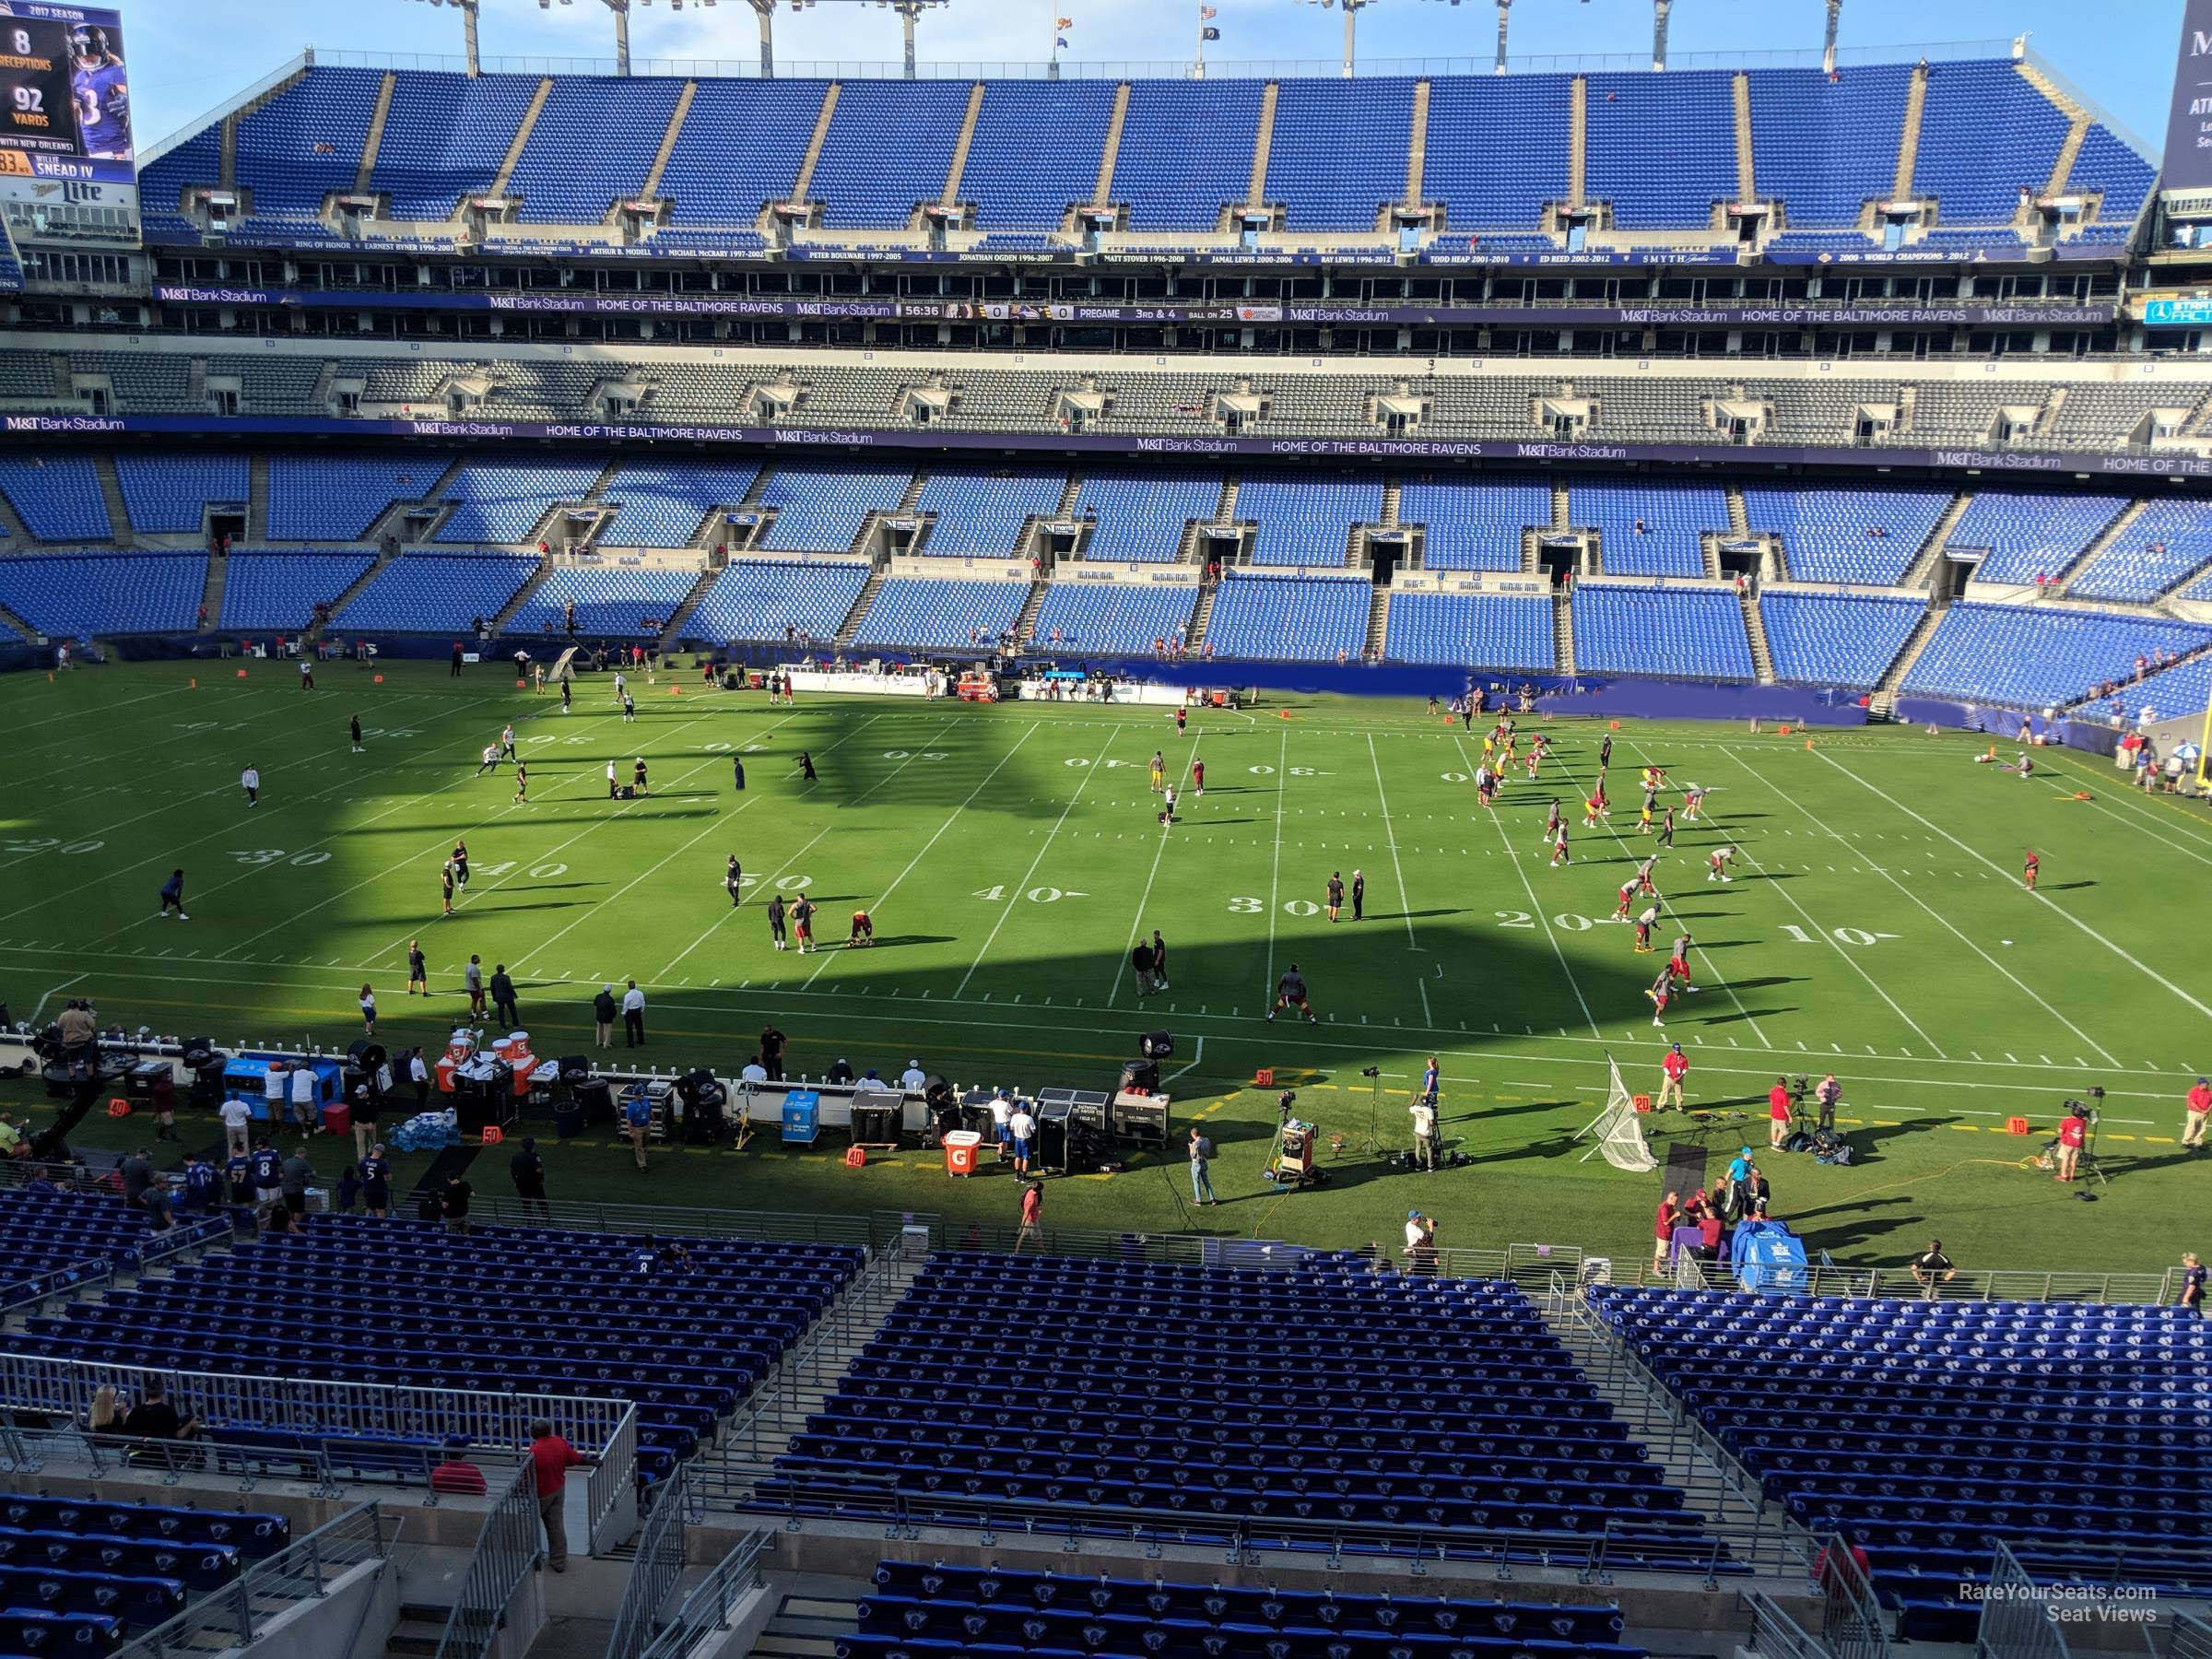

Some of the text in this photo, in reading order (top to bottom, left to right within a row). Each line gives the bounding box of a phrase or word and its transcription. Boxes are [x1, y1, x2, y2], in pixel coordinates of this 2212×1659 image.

[29, 6, 85, 20] 2017 SEASON
[14, 29, 31, 55] 8
[0, 55, 52, 71] RECEPTIONS
[14, 87, 44, 113] 92
[12, 112, 50, 127] YARDS
[20, 139, 36, 149] NEW
[39, 141, 74, 153] ORLEANS)
[35, 155, 60, 165] WILLIE
[37, 163, 94, 178] SNEAD IV
[365, 242, 394, 251] EARNEST
[419, 244, 454, 253] 1996-2003
[626, 249, 652, 257] MODELL
[867, 253, 902, 261] 1997-2005
[959, 253, 993, 262] JONATHAN
[1150, 255, 1185, 264] 1996-2008
[1211, 255, 1293, 264] JAMAL LEWIS 2000-2006
[1321, 255, 1391, 264] RAY LEWIS 1996-2012
[1430, 255, 1510, 264] TODD HEAP 2001-2010
[1539, 254, 1610, 264] ED REED 2002-2012
[1642, 255, 1685, 264] SMYTH
[1839, 252, 1970, 262] 2000 WORLD CHAMPIONS 2012
[160, 288, 266, 302] M&T Bank Stadium
[490, 297, 584, 310] M&T Bank Stadium
[596, 300, 783, 313] HOME OF THE BALTIMORE RAVENS
[796, 303, 890, 316] M&T Bank Stadium
[905, 306, 939, 315] 56:36
[993, 307, 1001, 318] 0
[1060, 308, 1068, 319] 0
[1080, 309, 1120, 319] PREGAME
[1135, 310, 1176, 319] 3RD & 4
[1188, 310, 1233, 320] BALL ON 25
[1289, 309, 1389, 322] M&T Bank Stadium
[1620, 310, 1727, 323] M&T Bank Stadium
[1742, 310, 1966, 322] HOME OF THE BALTIMORE RAVENS
[1983, 309, 2103, 322] M&T Bank Stadium
[6, 417, 125, 431] M&T Bank Stadium
[414, 422, 512, 436] M&T Bank Stadium
[547, 425, 743, 441] HOME OF THE BALTIMORE RAVENS
[775, 429, 873, 444] M&T Bank Stadium
[1136, 438, 1237, 452] M&T Bank Stadium
[1272, 441, 1481, 454] HOME OF THE BALTIMORE RAVENS
[1517, 443, 1626, 458] M&T Bank Stadium
[1936, 452, 2061, 468] M&T Bank Stadium
[2103, 458, 2212, 473] HOME OF THE
[971, 885, 1063, 903] 40
[1228, 896, 1320, 916] 30
[1494, 910, 1593, 931] 20
[1778, 924, 1877, 946] 10
[1258, 1071, 1271, 1085] 30
[111, 1100, 125, 1115] 40
[1636, 1098, 1649, 1111] 20
[2012, 1120, 2025, 1133] 10
[484, 1128, 498, 1143] 50
[849, 1150, 862, 1165] 40
[952, 1149, 967, 1166] G
[260, 1161, 270, 1177] 8
[367, 1167, 375, 1180] 5
